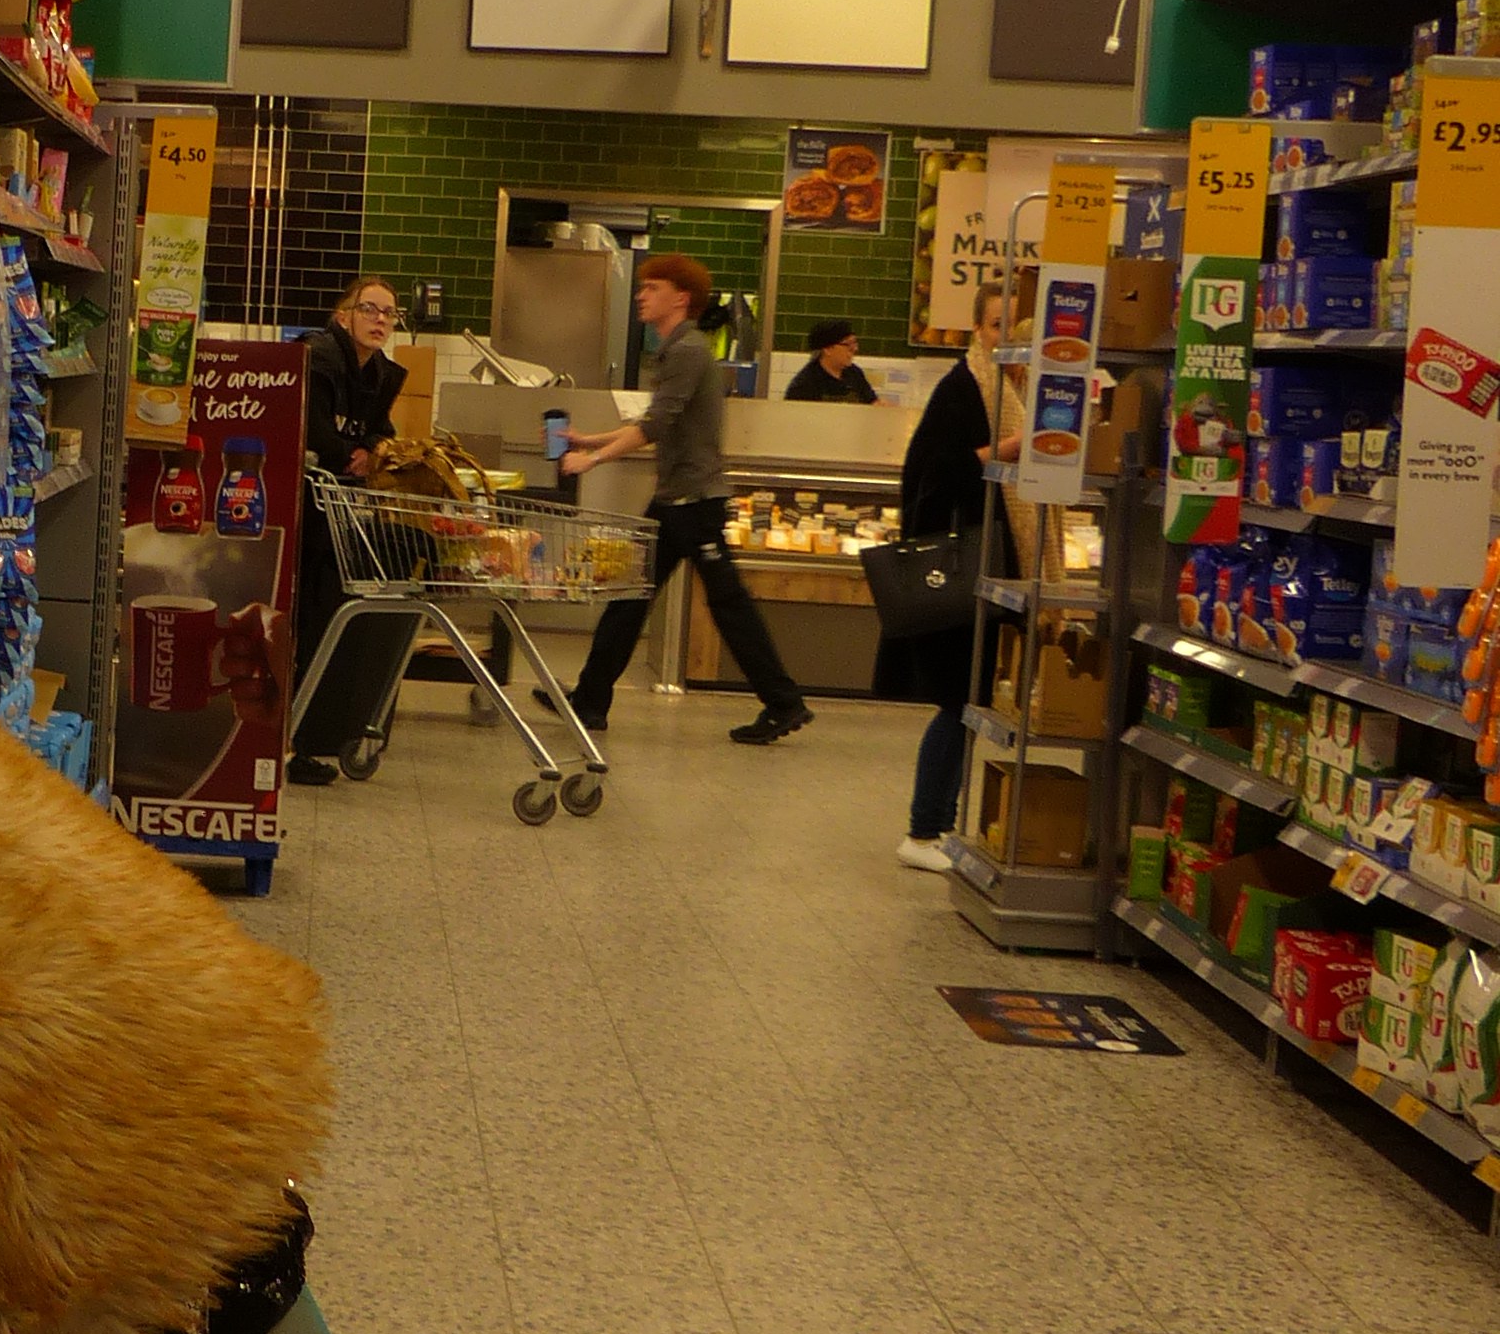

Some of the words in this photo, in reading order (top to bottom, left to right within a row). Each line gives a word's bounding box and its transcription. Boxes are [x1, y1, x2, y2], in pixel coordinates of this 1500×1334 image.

[1433, 120, 1500, 152] £2.95
[158, 143, 207, 166] £4.50
[1198, 169, 1256, 194] £5.25
[1052, 294, 1089, 312] Tetley
[1197, 282, 1240, 317] PG
[196, 351, 220, 363] njoy
[220, 352, 240, 363] our
[226, 369, 298, 390] aroma
[1042, 387, 1079, 405] Tetley
[204, 394, 266, 422] taste
[1418, 440, 1453, 454] Giving
[1454, 442, 1477, 454] you
[1454, 471, 1481, 482] brew
[1319, 576, 1361, 597] Tetley
